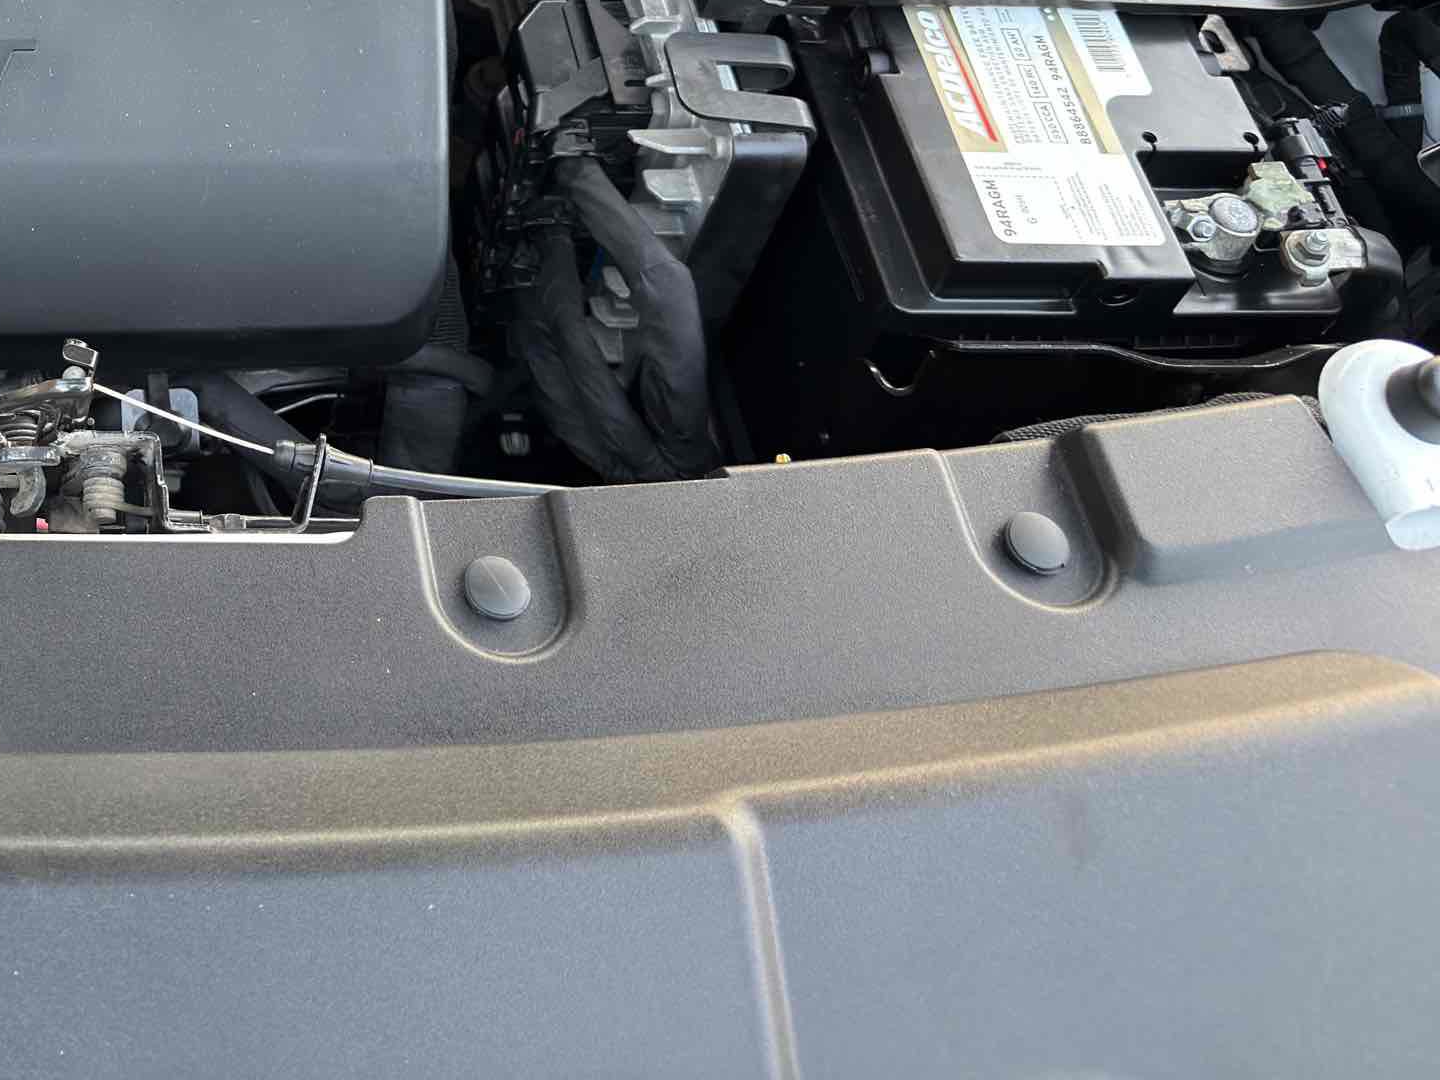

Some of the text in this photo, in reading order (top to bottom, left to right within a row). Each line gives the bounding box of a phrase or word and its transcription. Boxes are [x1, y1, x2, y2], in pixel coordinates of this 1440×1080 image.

[916, 9, 987, 137] ACDelco
[1032, 35, 1063, 81] 94RAGM
[982, 179, 1017, 237] 94RAGM
